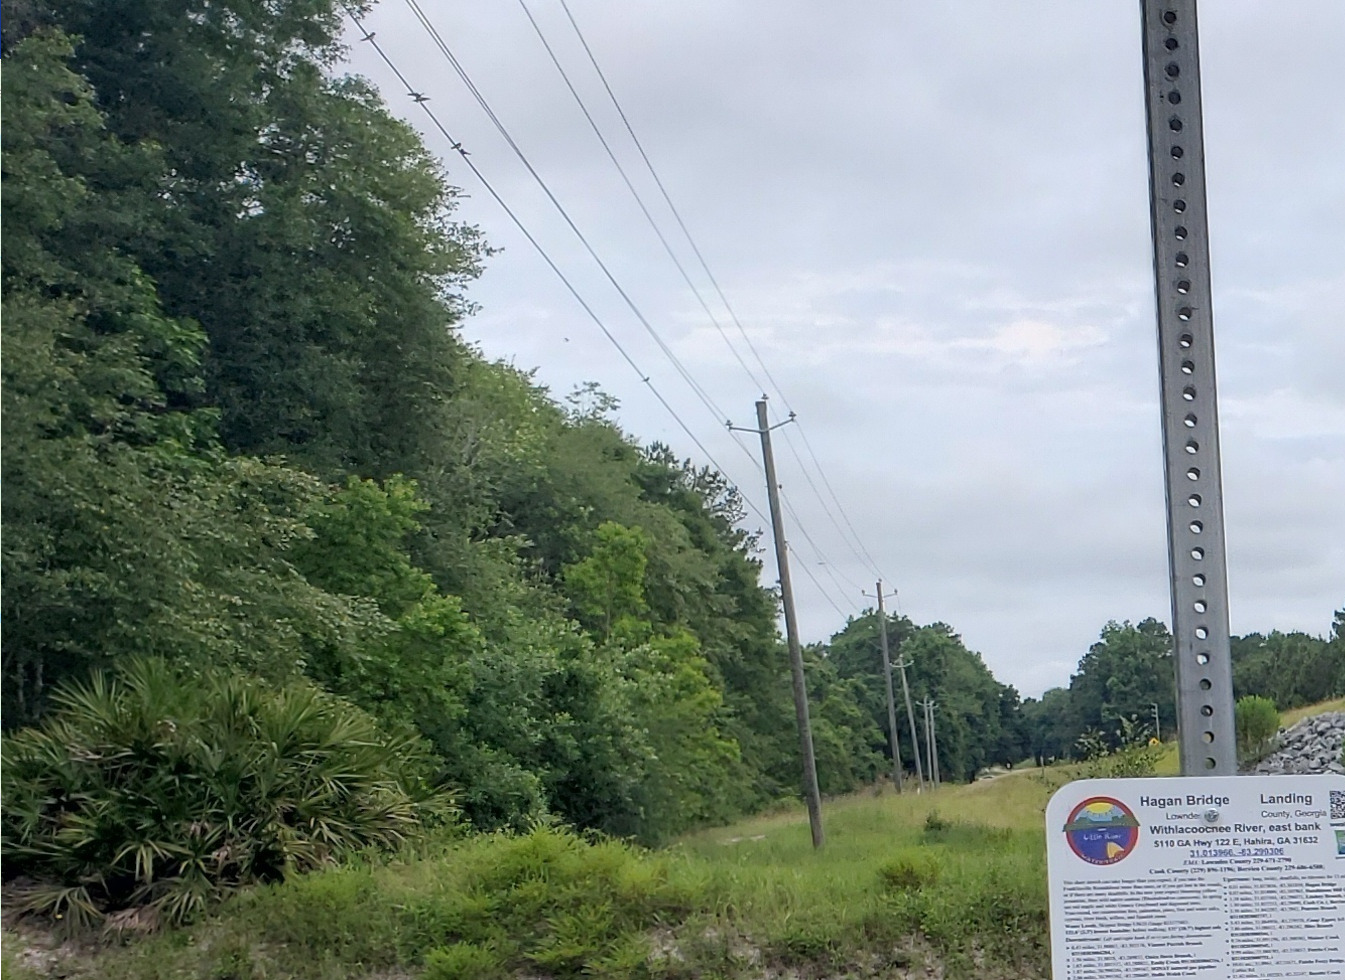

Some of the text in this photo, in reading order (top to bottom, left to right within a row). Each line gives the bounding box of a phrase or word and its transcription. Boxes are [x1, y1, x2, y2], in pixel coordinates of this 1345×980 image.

[1140, 793, 1312, 808] Hagan Bridge Landing
[1261, 810, 1293, 819] County,
[1295, 809, 1327, 818] Georgia
[1234, 823, 1266, 833] River,
[1269, 823, 1292, 832] east
[1295, 822, 1321, 831] bank
[1154, 840, 1175, 848] 5110
[1177, 839, 1191, 847] GA
[1194, 839, 1212, 848] Hwy
[1215, 838, 1230, 846] 122
[1232, 838, 1242, 846] E,
[1244, 837, 1275, 845] Hahira,
[1293, 836, 1318, 844] 31632
